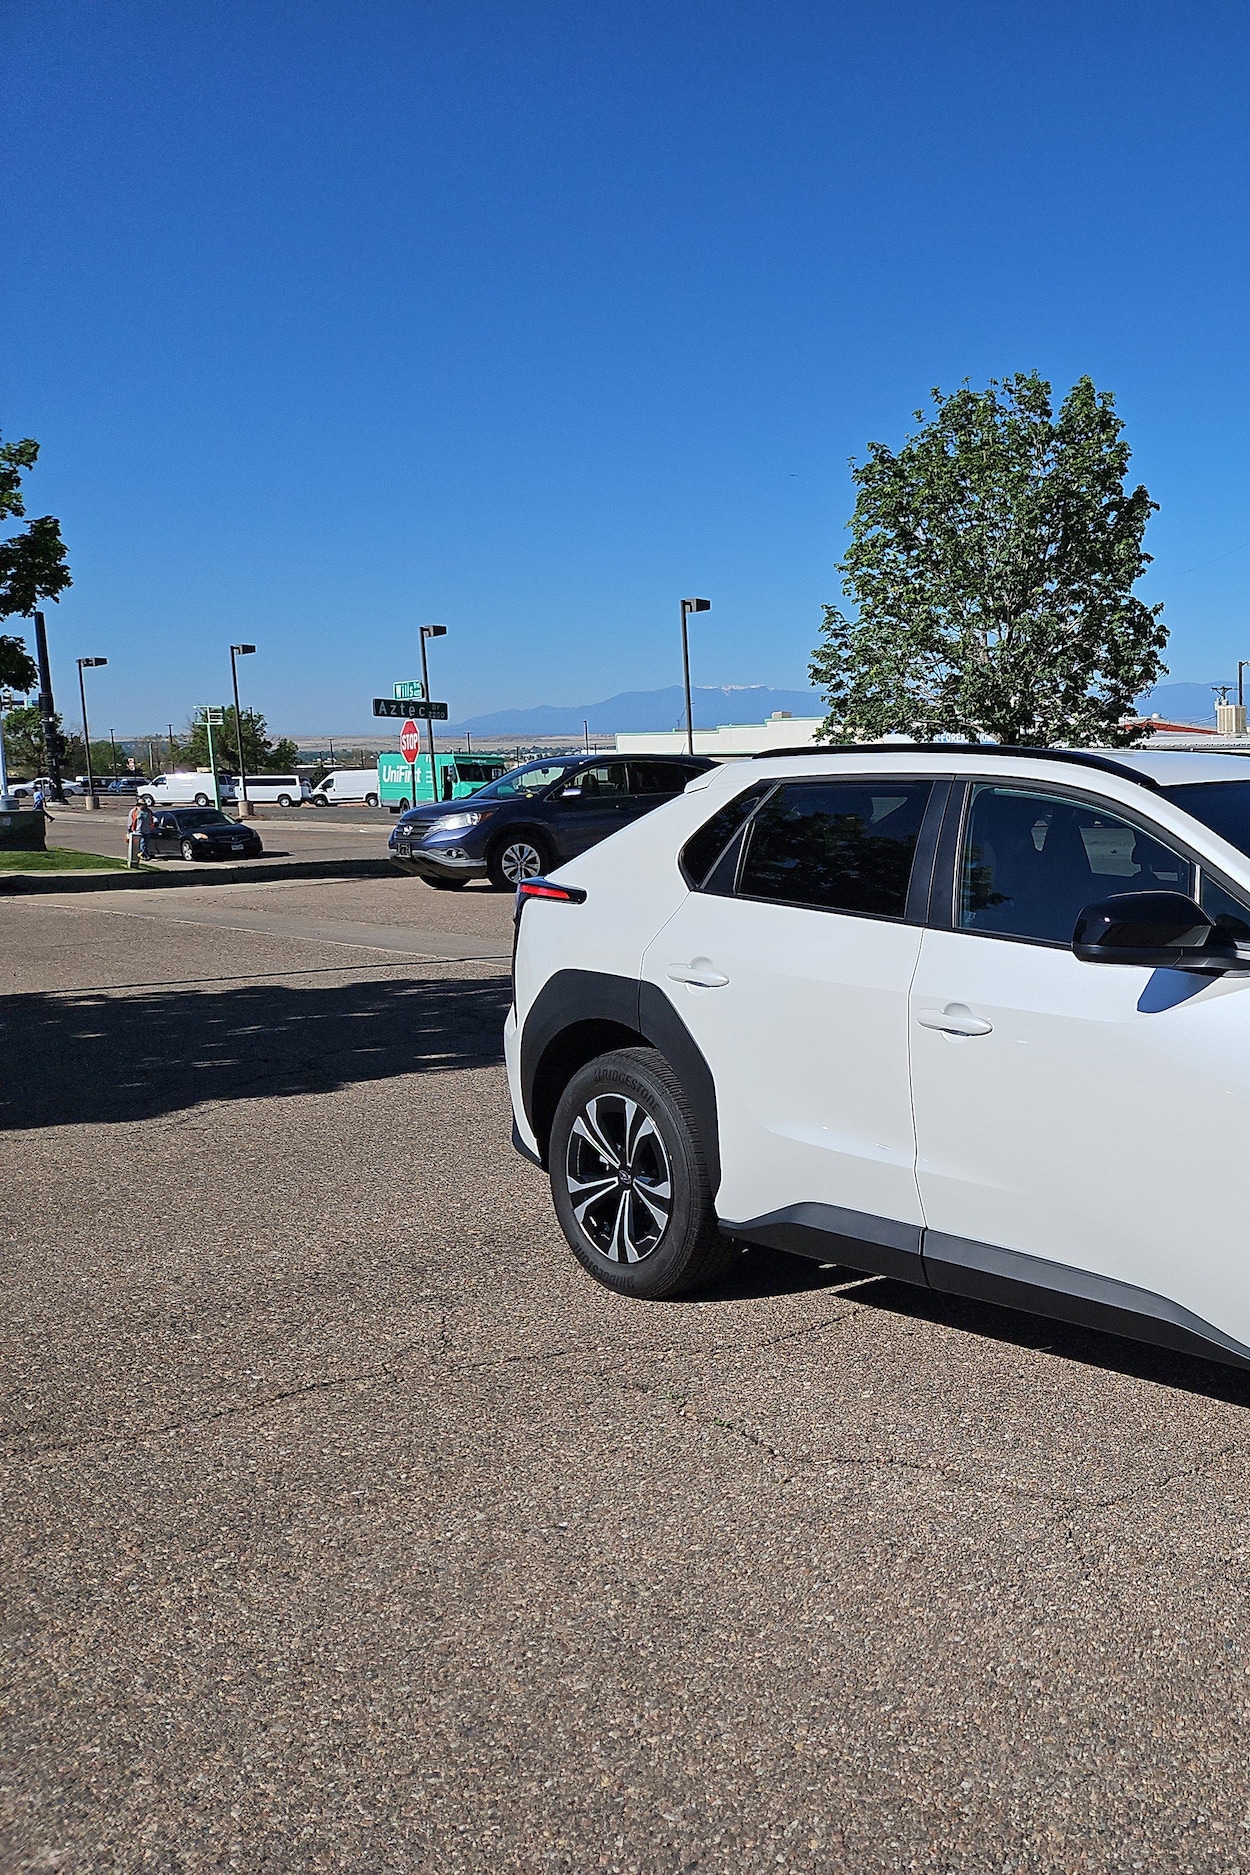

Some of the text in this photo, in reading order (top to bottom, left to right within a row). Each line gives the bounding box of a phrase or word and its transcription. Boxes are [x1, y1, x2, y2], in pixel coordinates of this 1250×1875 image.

[379, 701, 440, 717] Aztec Dr
[428, 711, 446, 719] 2200
[402, 733, 418, 750] STOP
[382, 765, 422, 783] UniFirt
